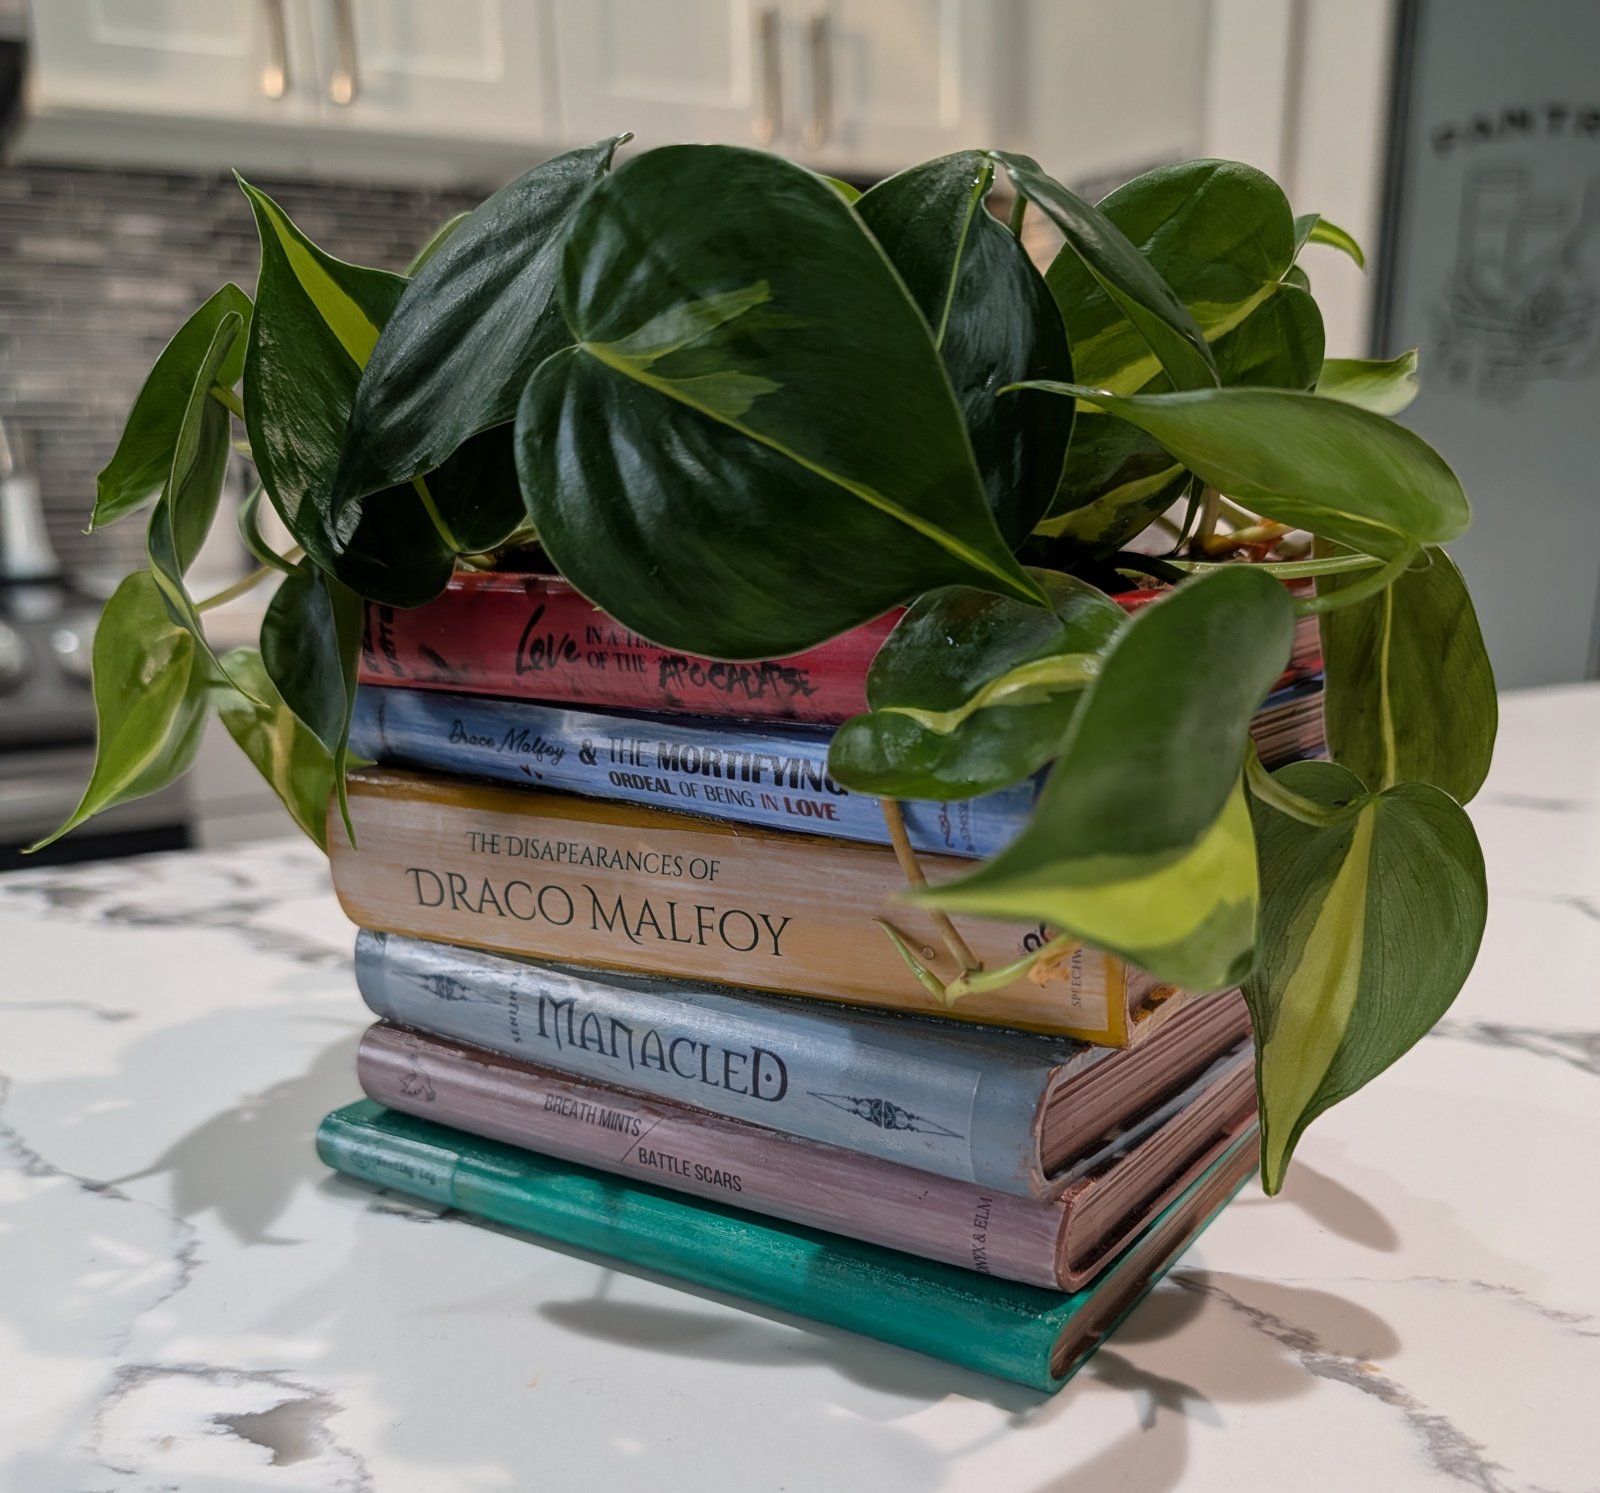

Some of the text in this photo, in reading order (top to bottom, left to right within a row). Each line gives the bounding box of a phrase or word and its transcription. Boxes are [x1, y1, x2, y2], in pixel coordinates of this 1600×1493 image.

[516, 605, 581, 676] Love
[586, 625, 603, 646] IN
[608, 629, 619, 647] A
[586, 650, 818, 699] OF THE APOCALYPSE
[449, 719, 496, 748] Draco
[496, 727, 566, 766] Malfoy
[579, 738, 598, 767] &
[608, 736, 650, 768] THE
[608, 770, 841, 822] ORDEAL OF BEING IN LOVE
[466, 831, 721, 882] THE DISAPEARANCES OF
[405, 867, 793, 957] DRACO MALFOY
[536, 988, 789, 1102] MANACLED
[544, 1092, 642, 1137] BREATH MINTS
[638, 1146, 743, 1193] BATTLE SCARS
[971, 1232, 987, 1244] &
[973, 1196, 994, 1231] ELM
